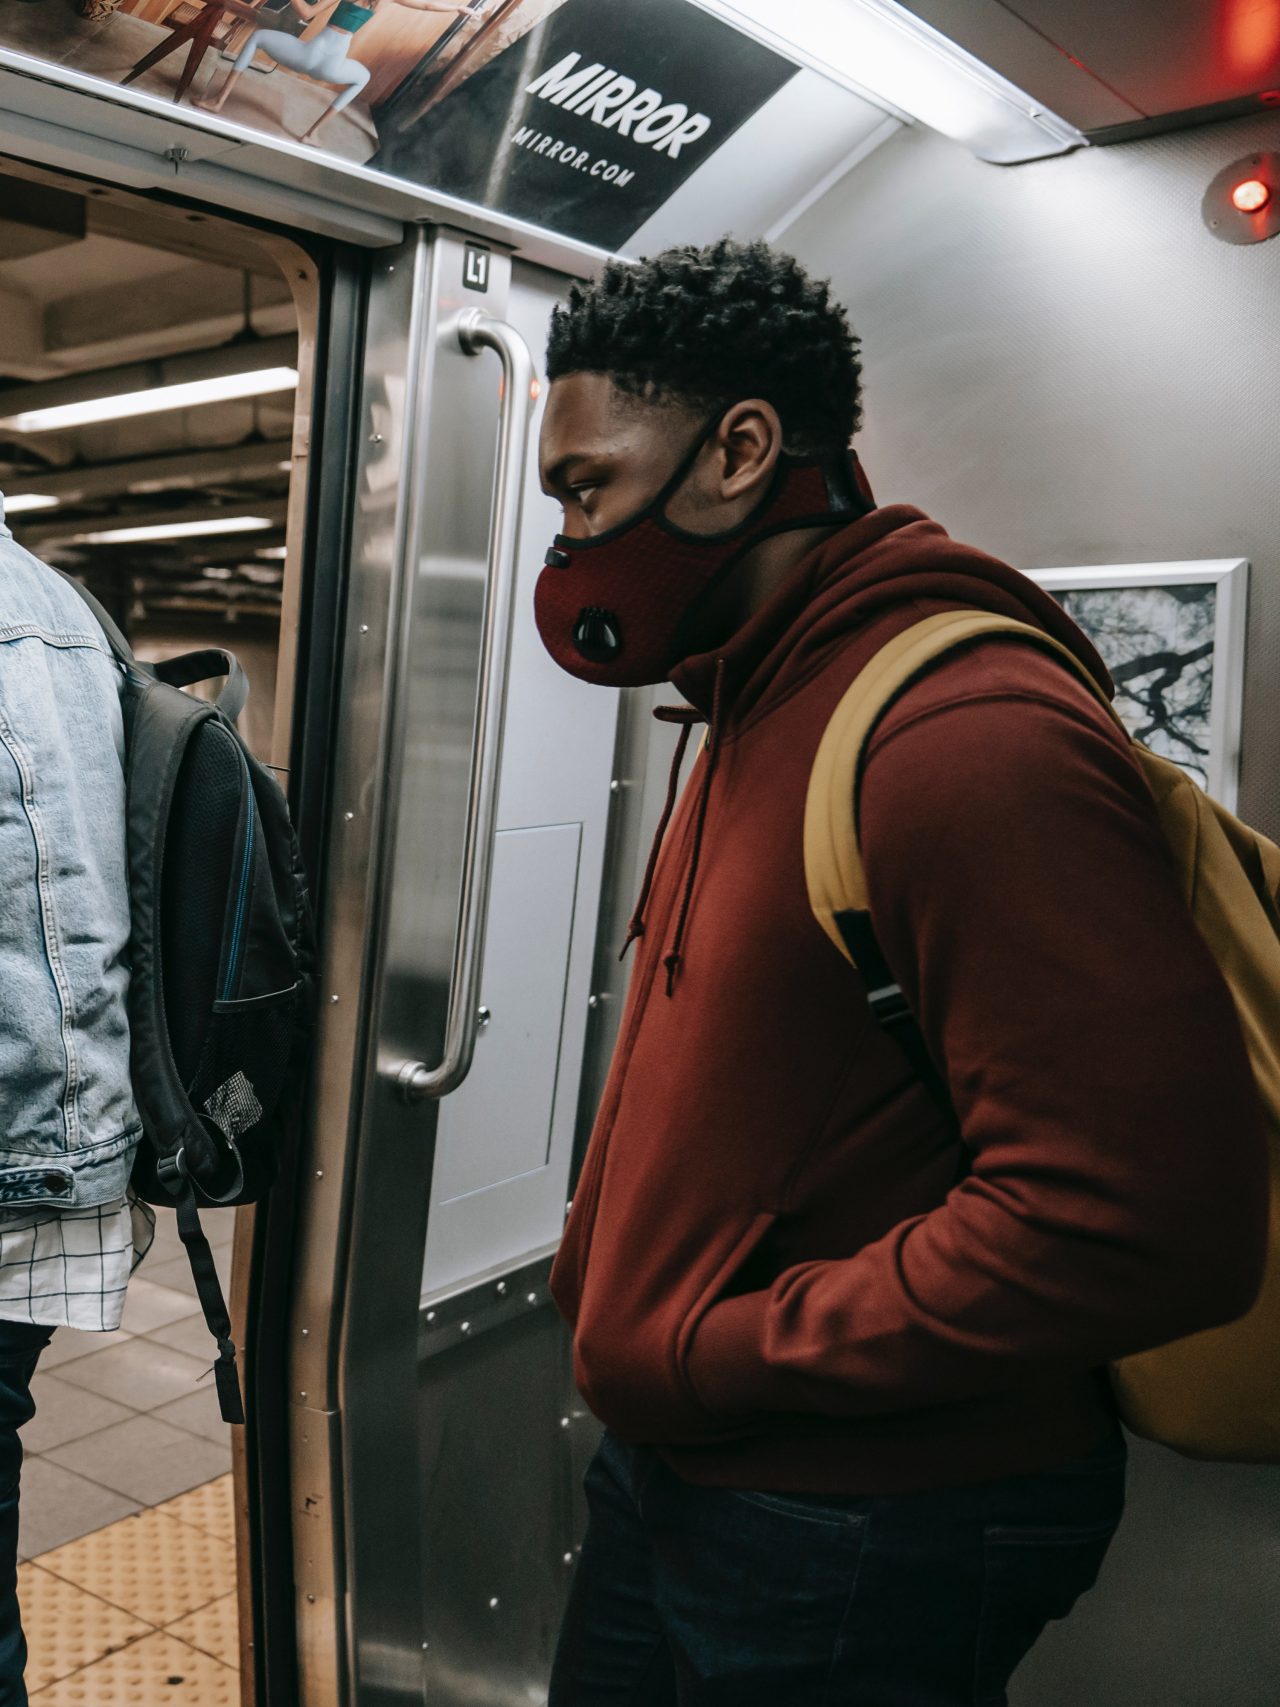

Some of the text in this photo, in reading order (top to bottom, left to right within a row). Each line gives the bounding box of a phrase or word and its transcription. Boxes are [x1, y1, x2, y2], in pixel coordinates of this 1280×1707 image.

[524, 51, 711, 160] MIRROR
[510, 125, 636, 188] MIRROR.COM
[466, 251, 487, 285] L1
